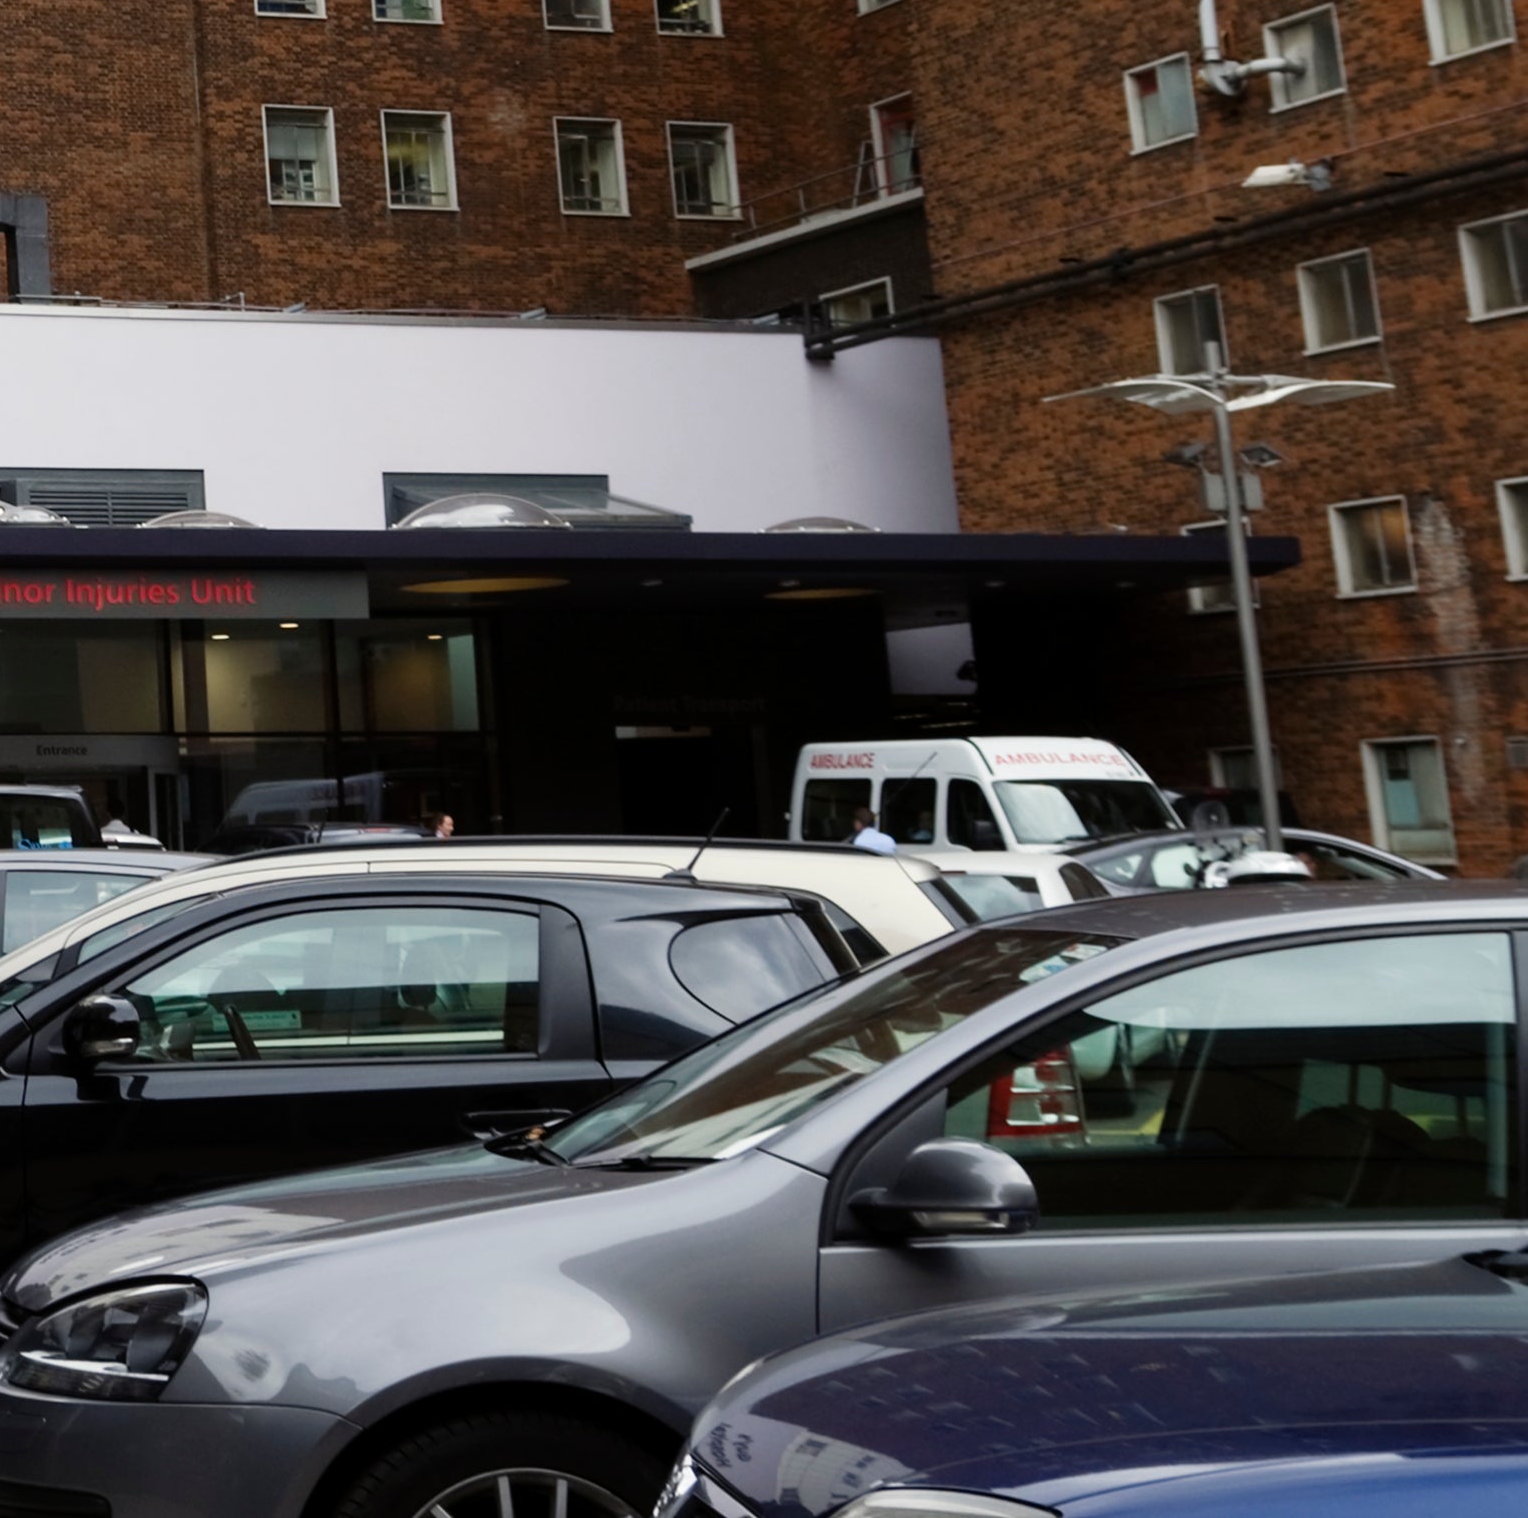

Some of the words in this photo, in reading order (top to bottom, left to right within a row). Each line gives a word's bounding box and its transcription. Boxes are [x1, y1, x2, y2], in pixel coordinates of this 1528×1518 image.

[67, 578, 179, 612] Injuries
[191, 578, 256, 605] Unit
[36, 745, 88, 756] Entrance
[810, 752, 875, 770] AMBULANCE
[995, 753, 1125, 767] AMBULANCE
